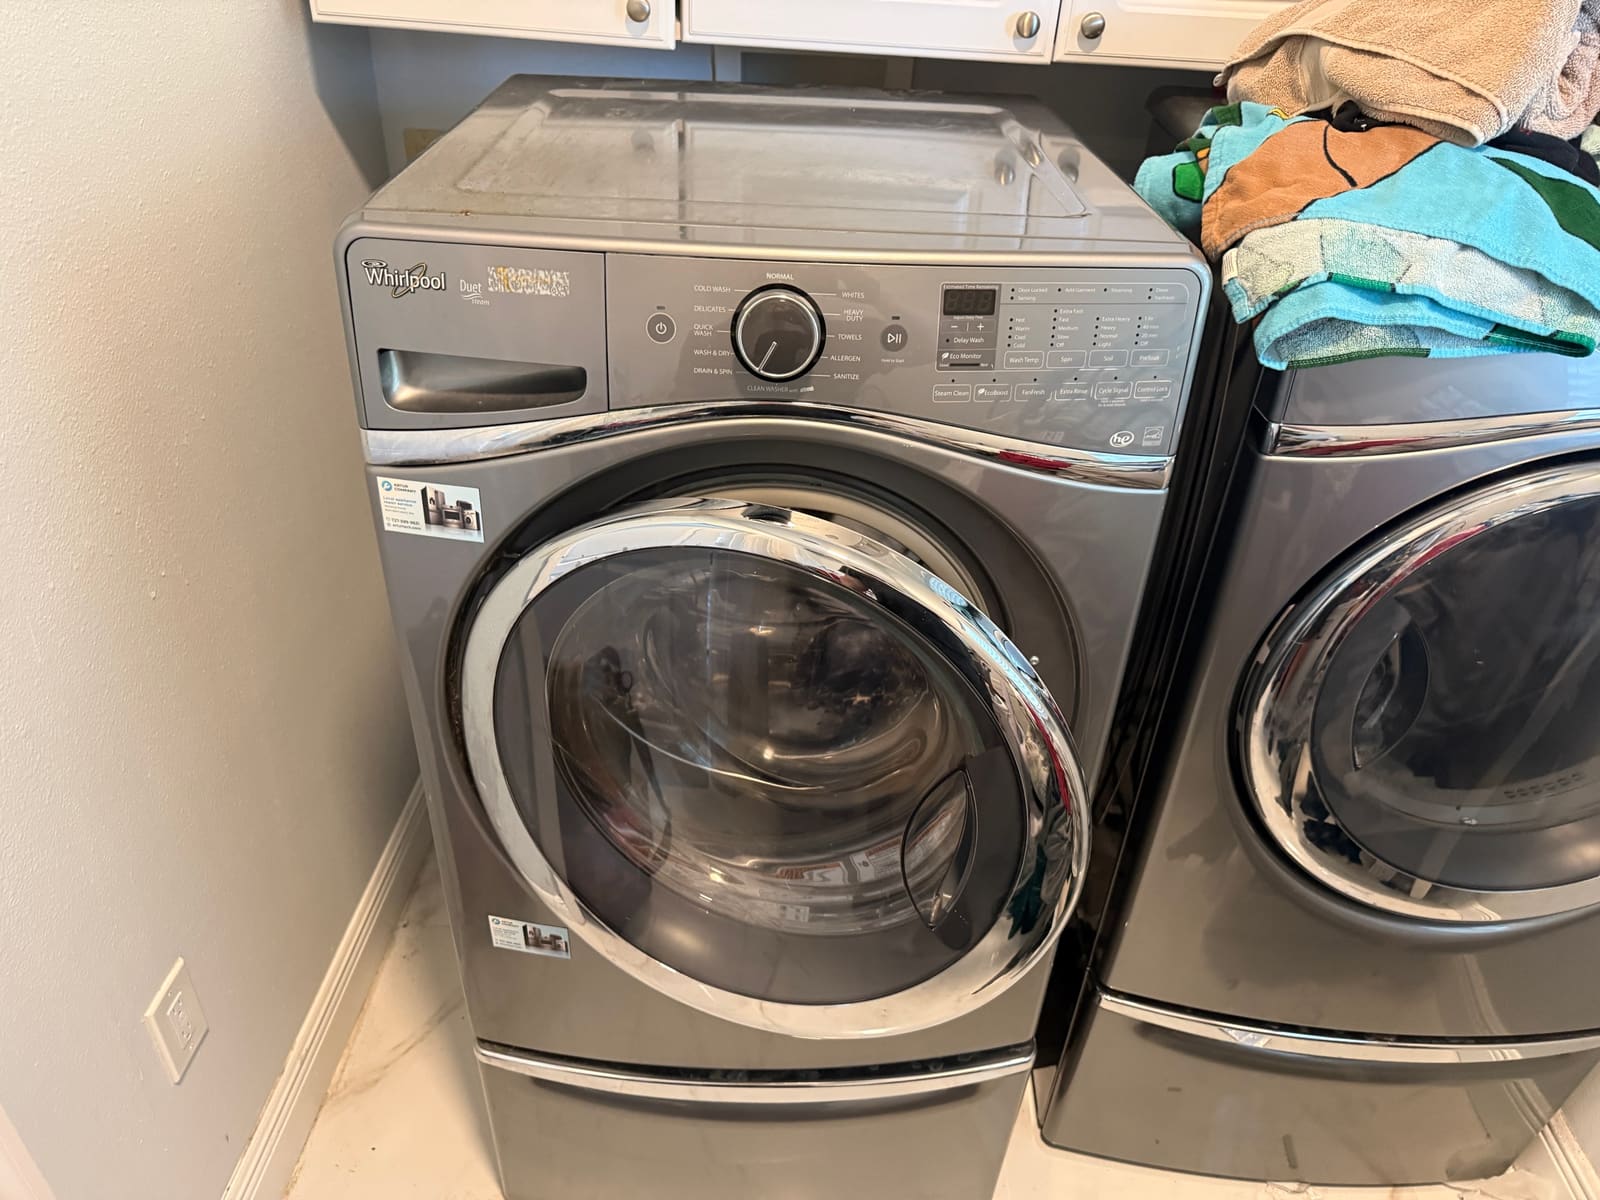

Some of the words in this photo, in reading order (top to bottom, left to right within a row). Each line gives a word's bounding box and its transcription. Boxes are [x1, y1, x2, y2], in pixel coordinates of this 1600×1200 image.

[364, 265, 446, 294] Whirlpool
[766, 272, 794, 280] NORMAL
[460, 280, 482, 292] Duet
